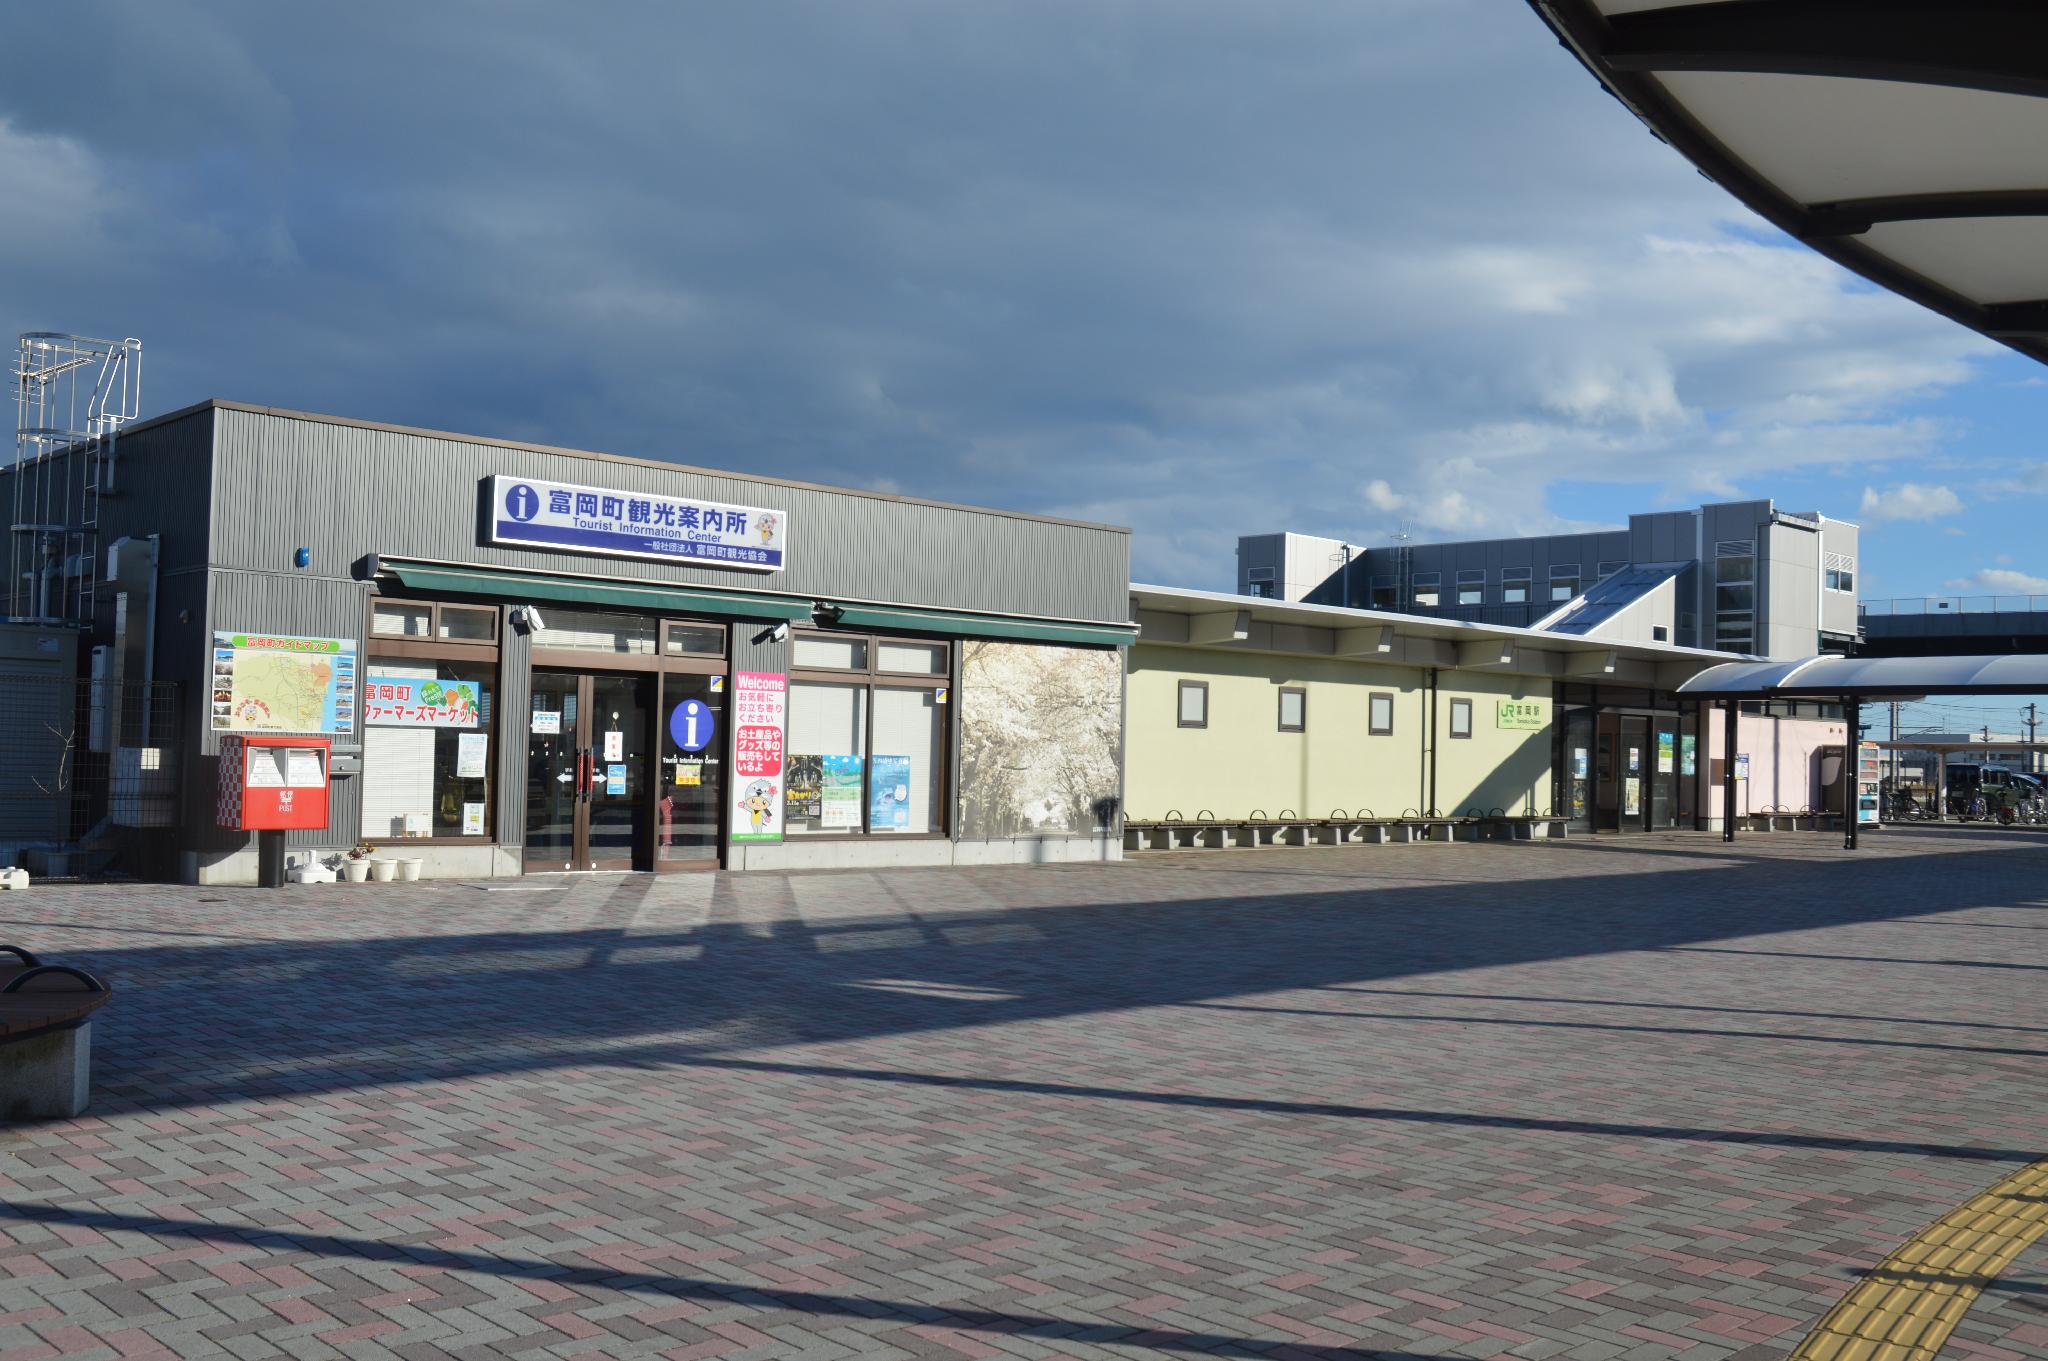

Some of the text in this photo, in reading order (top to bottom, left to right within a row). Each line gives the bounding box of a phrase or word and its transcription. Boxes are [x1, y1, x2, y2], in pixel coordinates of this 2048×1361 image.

[549, 490, 747, 535] 富岡町観光案内所
[573, 517, 722, 543] Tourist Information Center
[643, 540, 768, 562] 一般社団法人 富岡町観光協会
[247, 636, 329, 651] 富岡町ガイドマップ
[738, 675, 784, 691] Welcome
[738, 692, 775, 702] お気軽に
[738, 703, 783, 713] お立ち寄り
[1501, 704, 1515, 718] JR
[738, 714, 775, 723] ください
[738, 729, 781, 741] お土産品や
[738, 740, 781, 751] グッズ等の
[663, 756, 678, 764] Tourist
[737, 750, 781, 762] 販売もして
[737, 762, 764, 772] いるよ
[278, 804, 293, 813] POST
